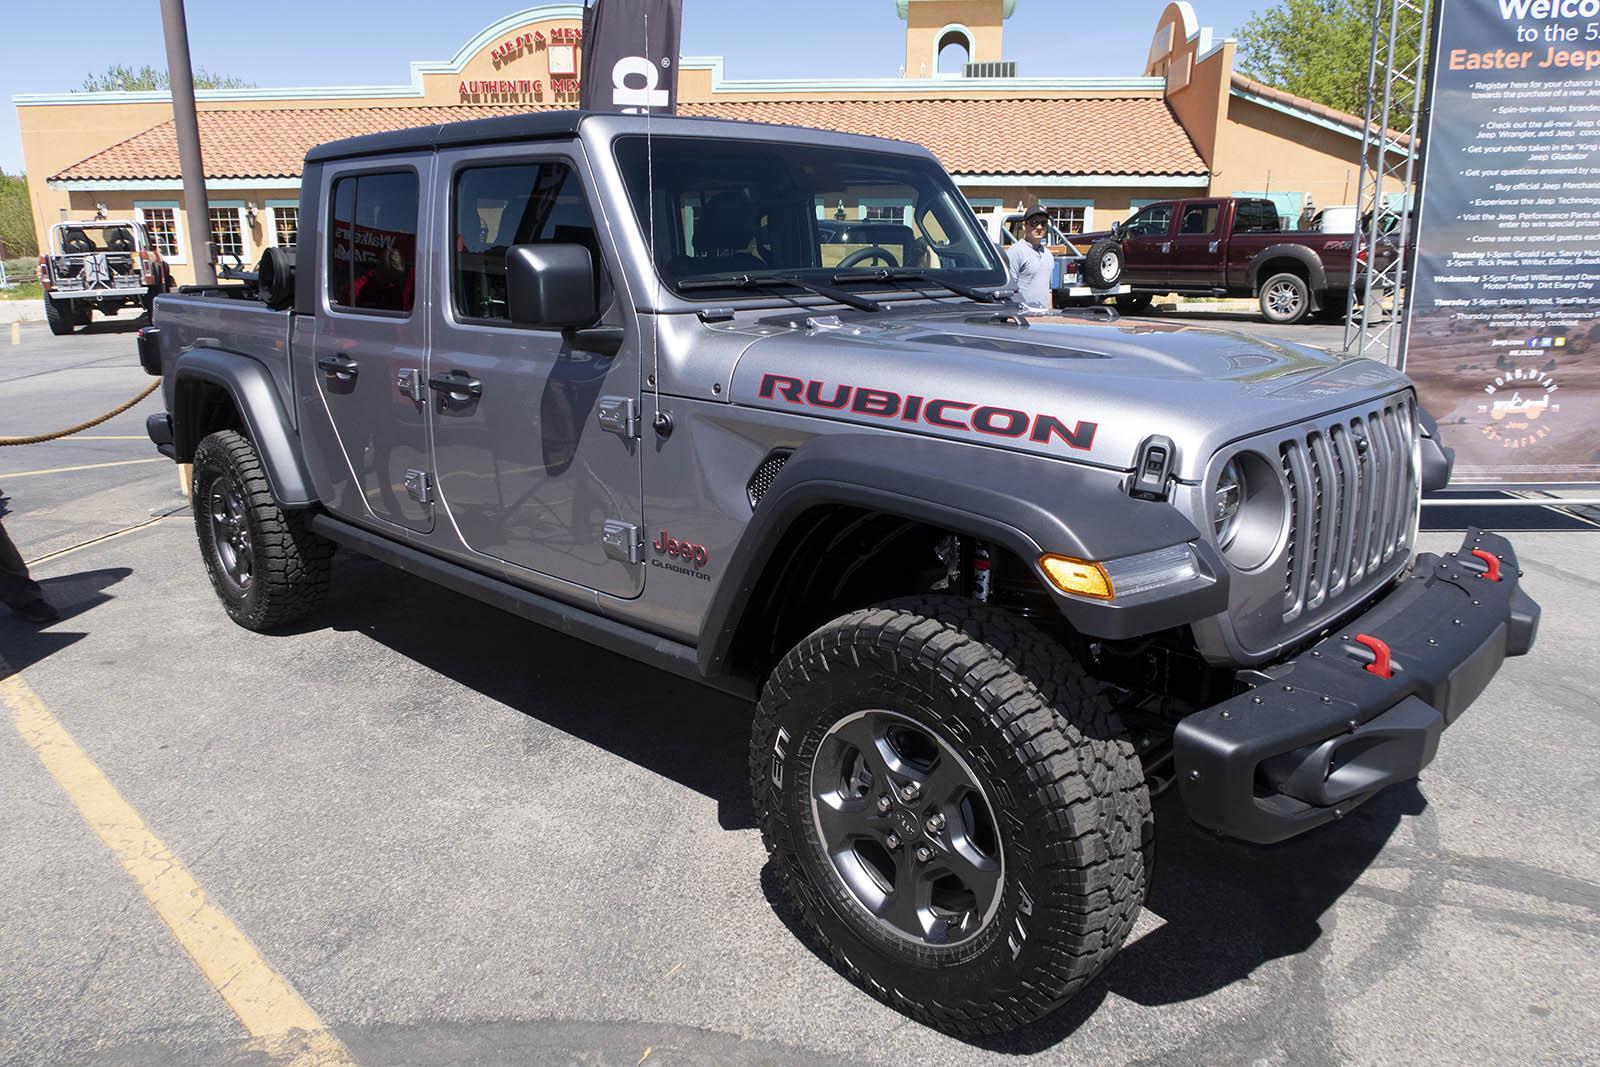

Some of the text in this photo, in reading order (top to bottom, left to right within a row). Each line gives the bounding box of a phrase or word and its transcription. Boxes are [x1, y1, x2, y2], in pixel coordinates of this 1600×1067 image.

[1517, 22, 1600, 42] to the 5
[490, 30, 546, 61] FIESTA
[1449, 47, 1600, 71] Easter Jeep
[459, 79, 542, 94] AUTHENTIC
[1475, 81, 1509, 90] Register
[1510, 81, 1529, 89] here
[1530, 80, 1542, 88] for
[1543, 81, 1563, 89] your
[1563, 80, 1593, 88] chance
[1553, 89, 1562, 97] of
[1546, 105, 1567, 113] Jeep
[1486, 121, 1511, 129] Check
[1513, 121, 1527, 129] out
[1574, 120, 1594, 128] Jeep
[1475, 131, 1496, 139] Jeep
[1555, 130, 1575, 138] Jeep
[1467, 145, 1483, 153] Get
[1484, 146, 1502, 154] your
[1502, 145, 1527, 154] photo
[1528, 144, 1550, 152] taken
[1528, 153, 1549, 161] Jeep
[1578, 167, 1589, 175] by
[1495, 183, 1511, 192] Buy
[1541, 182, 1560, 190] Jeep
[1520, 198, 1534, 206] the
[1535, 198, 1555, 206] Jeep
[1463, 213, 1480, 221] Visit
[1570, 211, 1591, 219] Parts
[1472, 235, 1496, 243] Come
[1452, 251, 1485, 259] Tuesday
[1477, 258, 1495, 267] Rick
[1433, 275, 1480, 283] Wednesday
[1510, 274, 1529, 282] Fred
[1564, 273, 1581, 281] and
[1537, 281, 1553, 289] Dirt
[1553, 281, 1577, 290] Every
[1577, 281, 1594, 290] Day
[1456, 312, 1491, 320] Thursday
[1523, 312, 1543, 320] Jeep
[1529, 320, 1546, 328] dog
[758, 373, 1099, 452] RUBICON
[651, 528, 709, 570] Jeep
[651, 558, 712, 583] GLADIATOR
